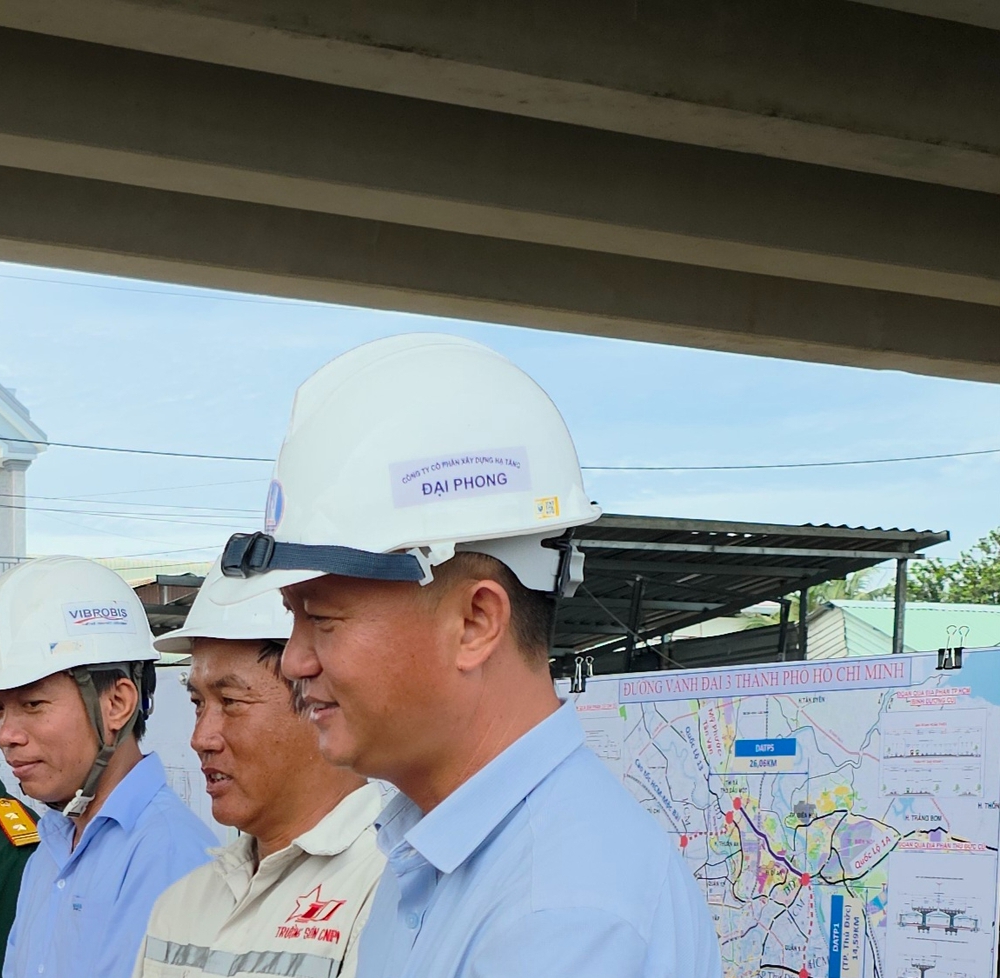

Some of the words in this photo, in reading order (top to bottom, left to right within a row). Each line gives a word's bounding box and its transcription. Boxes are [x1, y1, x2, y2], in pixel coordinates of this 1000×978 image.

[421, 480, 449, 497] ĐẠI
[453, 472, 508, 491] PHONG
[69, 608, 128, 619] VIBROBIS
[623, 676, 663, 697] ĐƯỜNG
[666, 674, 698, 693] VÀNH
[701, 675, 722, 691] ĐAI
[725, 675, 732, 690] 3
[735, 668, 779, 689] THÀNH
[783, 665, 809, 686] PHỐ
[813, 663, 833, 683] HỒ
[836, 661, 861, 682] CHÍ
[864, 662, 904, 681] MINH
[832, 923, 840, 952] DATP1
[852, 916, 860, 961] 14,59KM
